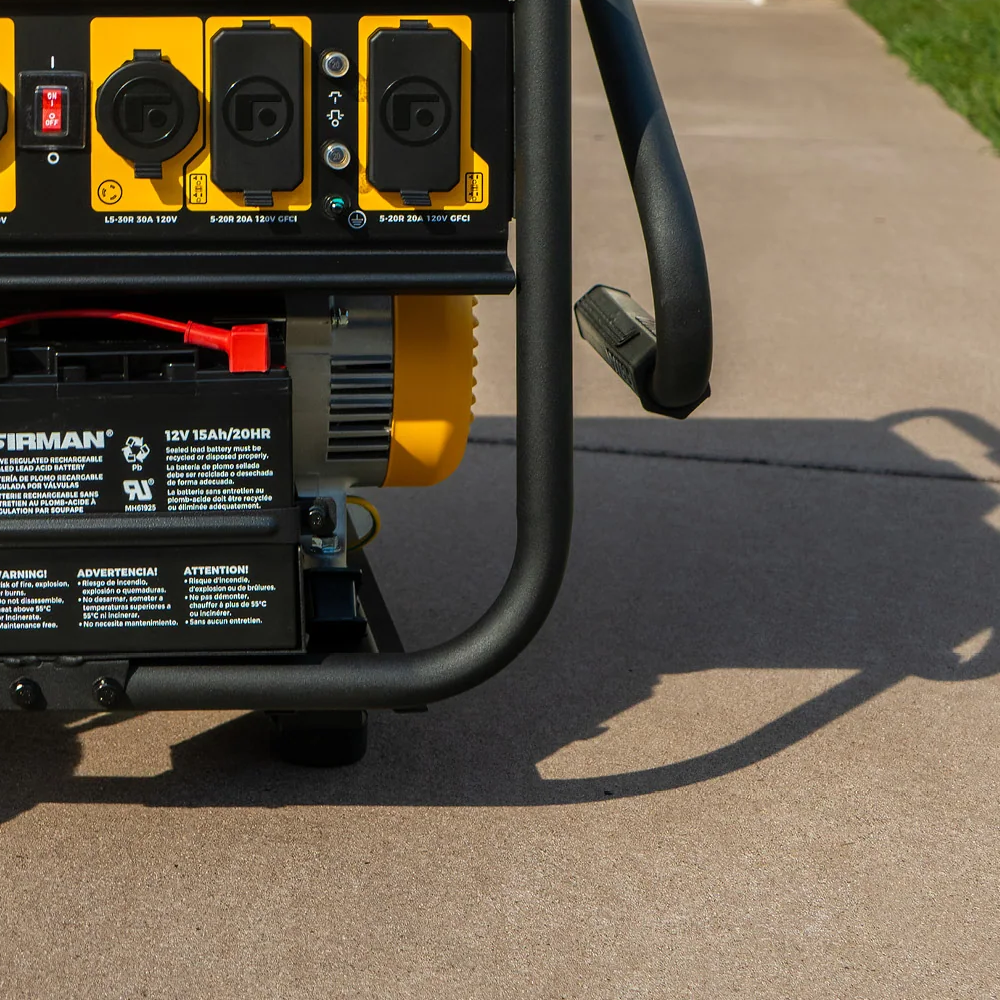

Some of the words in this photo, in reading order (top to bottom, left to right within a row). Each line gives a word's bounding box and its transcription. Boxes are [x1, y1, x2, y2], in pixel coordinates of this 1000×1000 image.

[165, 430, 189, 441] 12V
[193, 428, 271, 441] 15Ah/20HR
[166, 454, 195, 462] recycled
[206, 453, 237, 461] disposed
[124, 504, 156, 512] MH61925
